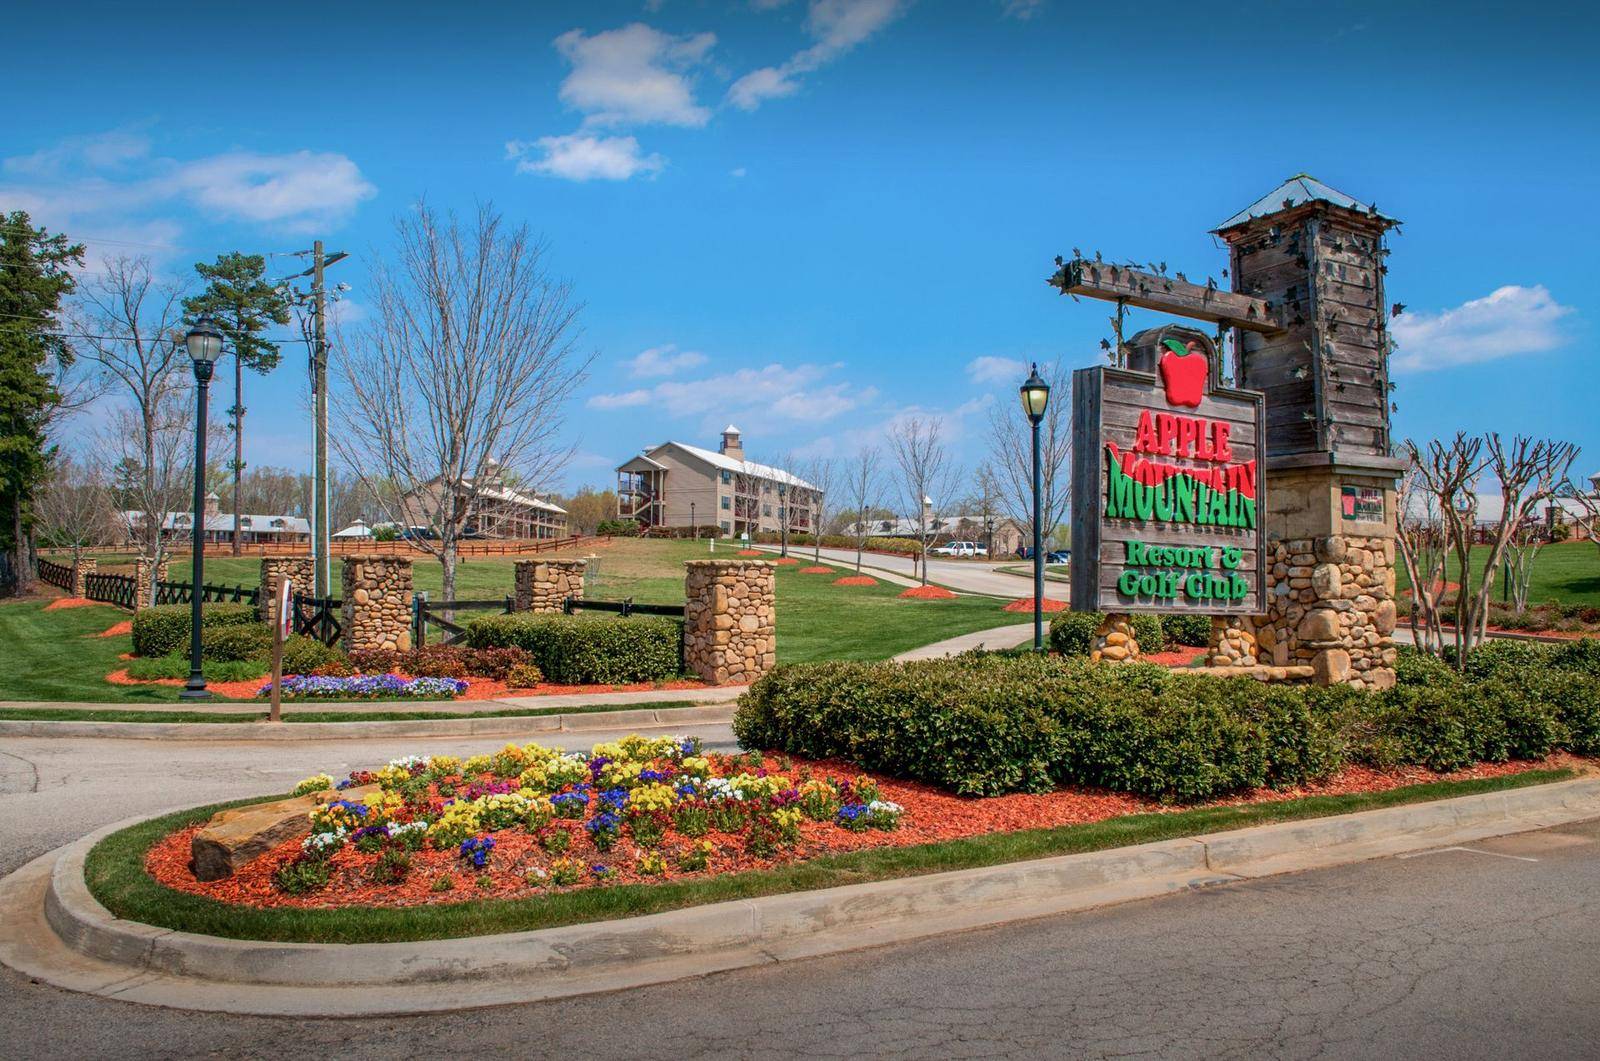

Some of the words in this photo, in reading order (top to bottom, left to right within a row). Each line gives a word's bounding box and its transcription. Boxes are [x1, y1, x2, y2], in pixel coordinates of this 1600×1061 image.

[1133, 409, 1232, 462] APPLE
[1106, 442, 1256, 528] MOUNTAIN
[1125, 541, 1214, 568] Resort
[1221, 545, 1242, 569] &
[1118, 570, 1180, 598] Golf
[1186, 572, 1248, 599] Club
